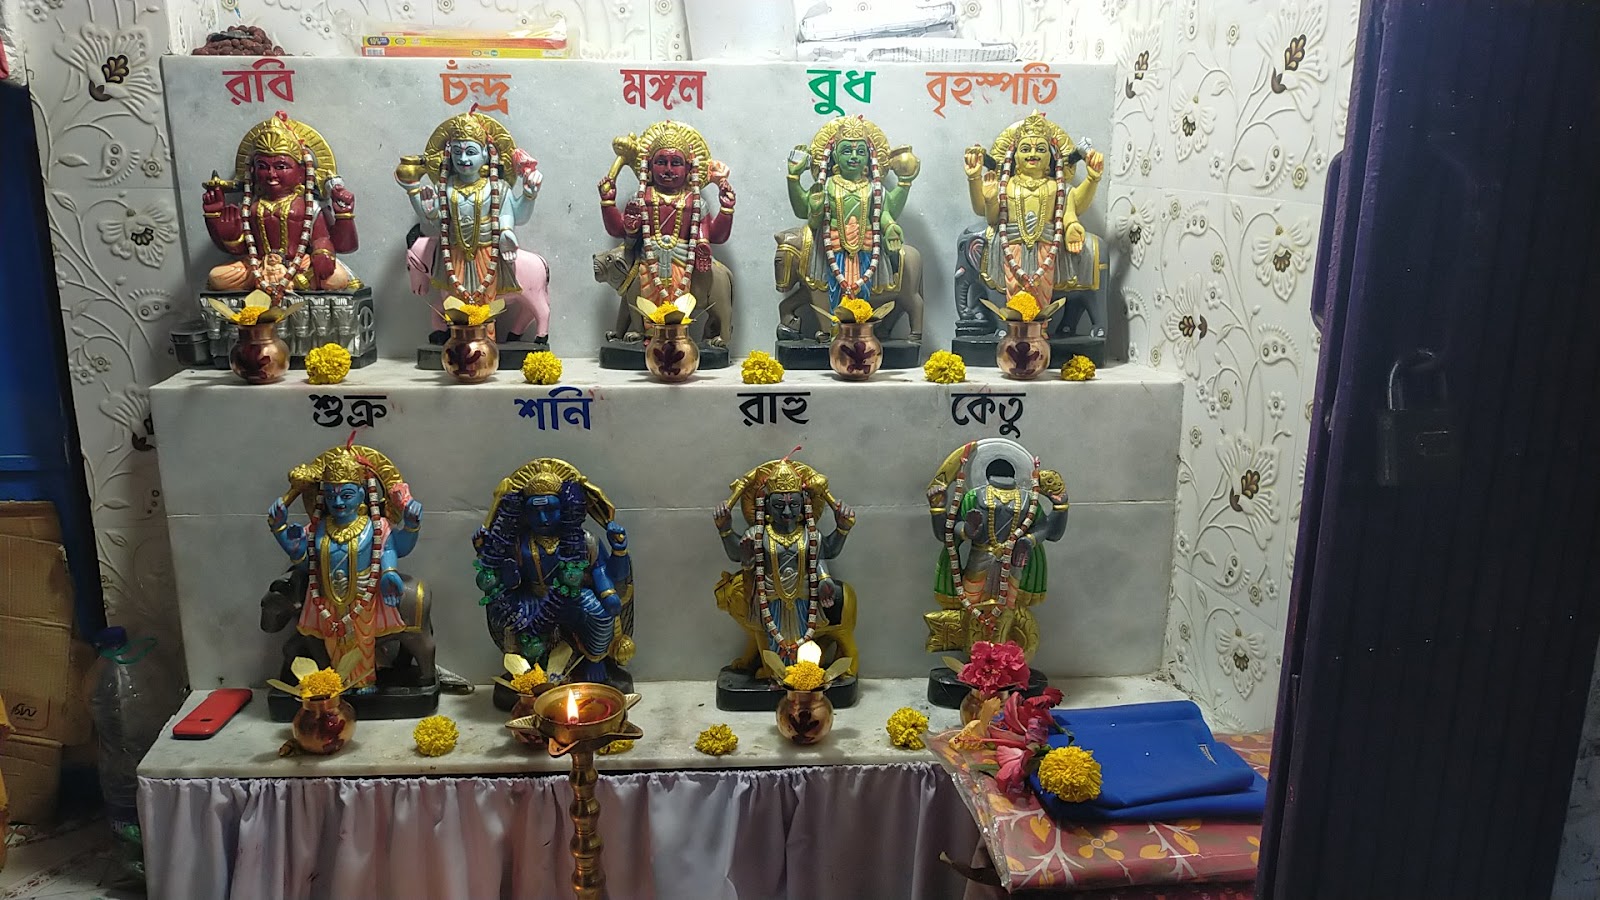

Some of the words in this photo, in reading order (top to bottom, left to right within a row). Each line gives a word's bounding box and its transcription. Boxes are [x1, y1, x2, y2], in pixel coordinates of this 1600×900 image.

[222, 58, 295, 105] রবি
[620, 69, 707, 110] মঙ্গল
[806, 69, 877, 117] বুধ
[926, 62, 1061, 118] বৃহস্পতি
[308, 393, 388, 428] শুক্র
[514, 386, 593, 431] শনি
[736, 391, 811, 427] রাহু
[950, 392, 1027, 438] কেতু
